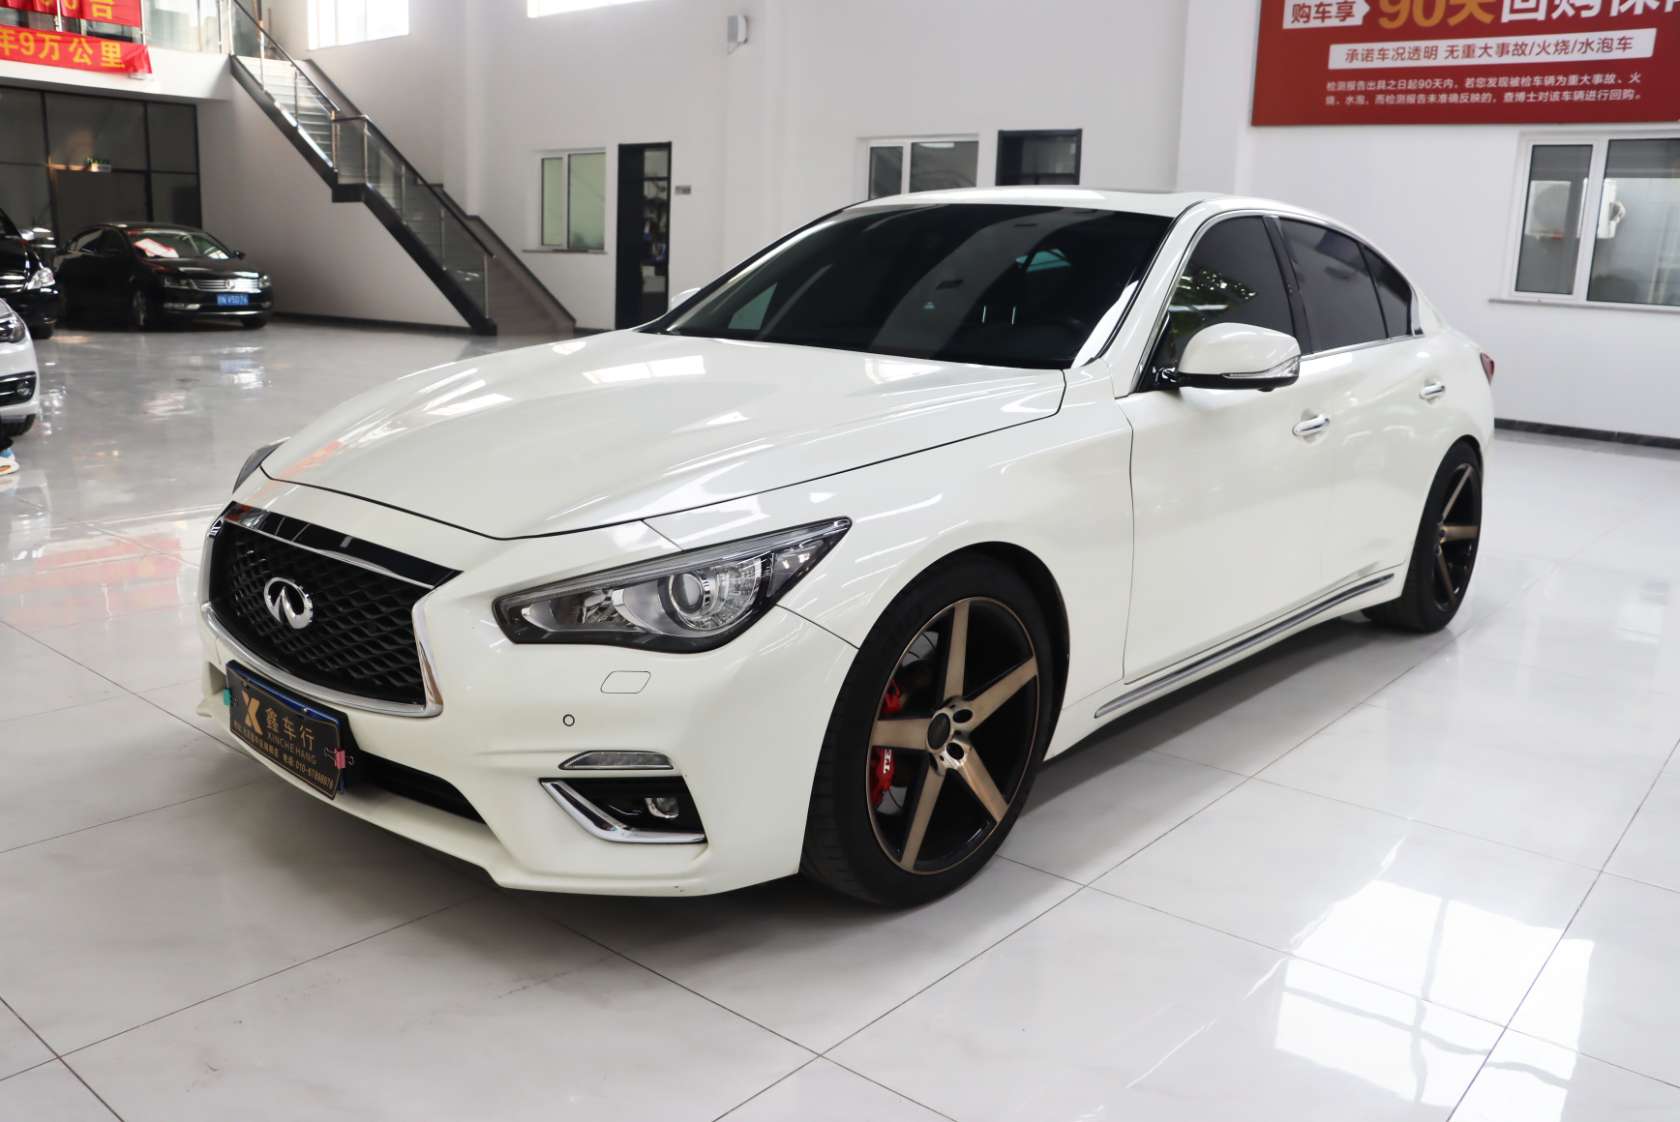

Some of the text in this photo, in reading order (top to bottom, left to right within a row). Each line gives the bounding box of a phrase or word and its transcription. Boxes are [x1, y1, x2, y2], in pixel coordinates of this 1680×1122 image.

[1291, 1, 1356, 24] 购车享
[1345, 36, 1634, 64] 承诺车况透明 无重大事故/火烧/水泡车
